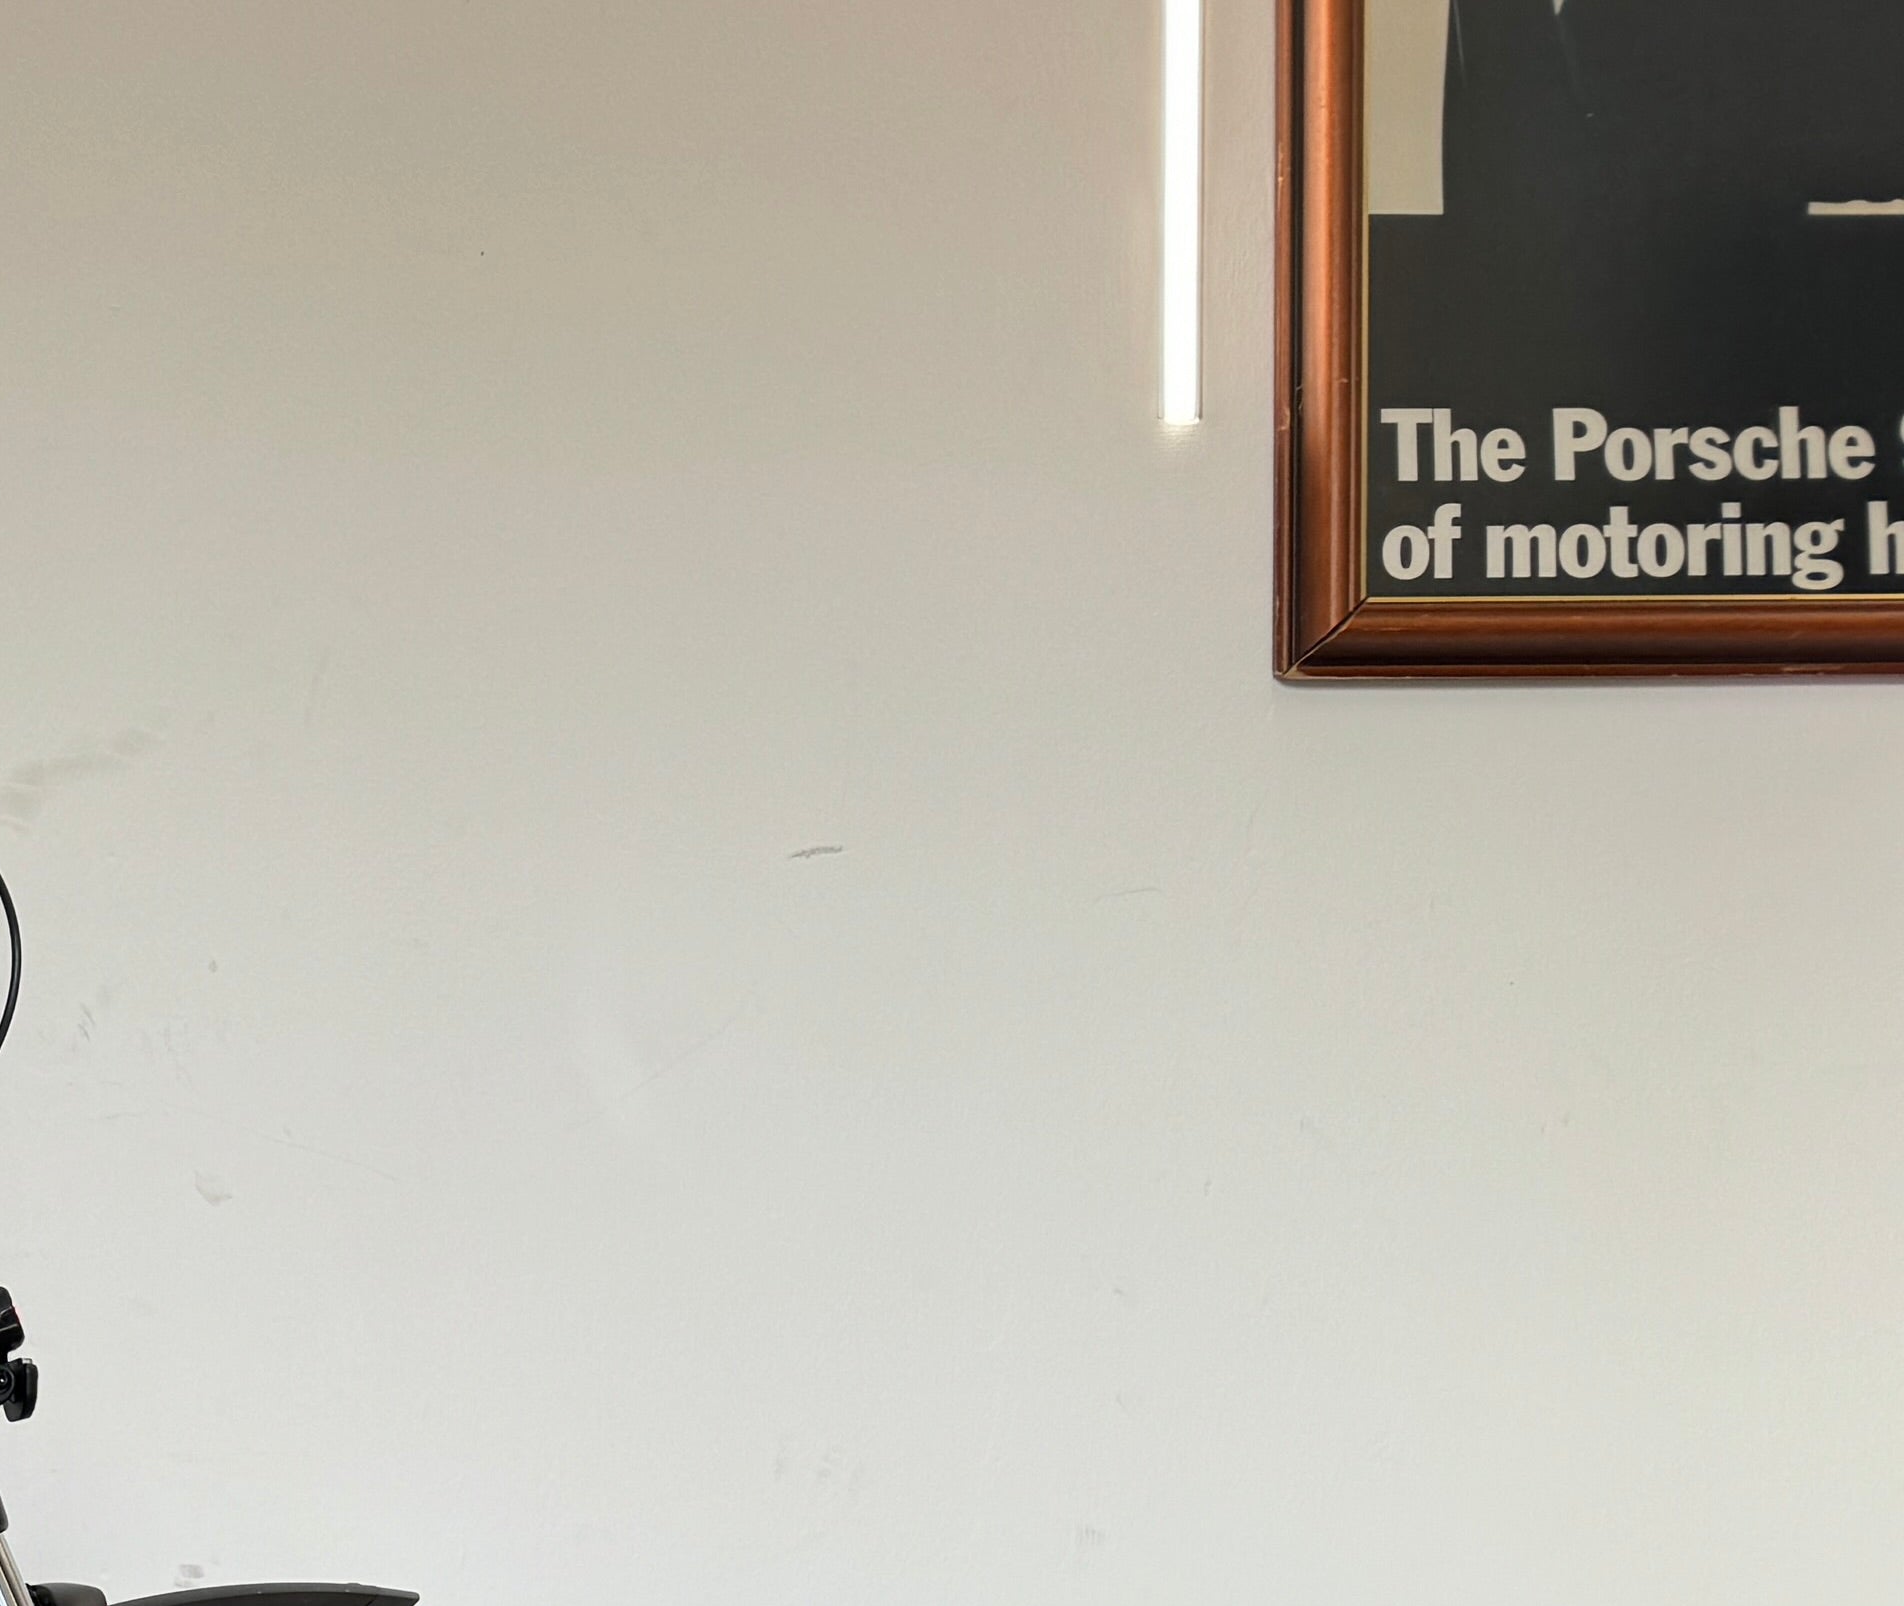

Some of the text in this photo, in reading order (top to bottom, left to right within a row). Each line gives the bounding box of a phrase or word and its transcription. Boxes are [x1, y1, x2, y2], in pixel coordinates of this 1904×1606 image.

[1379, 406, 1527, 483] The
[1551, 404, 1877, 482] Porsche
[1380, 502, 1462, 581] of
[1485, 501, 1845, 591] motoring
